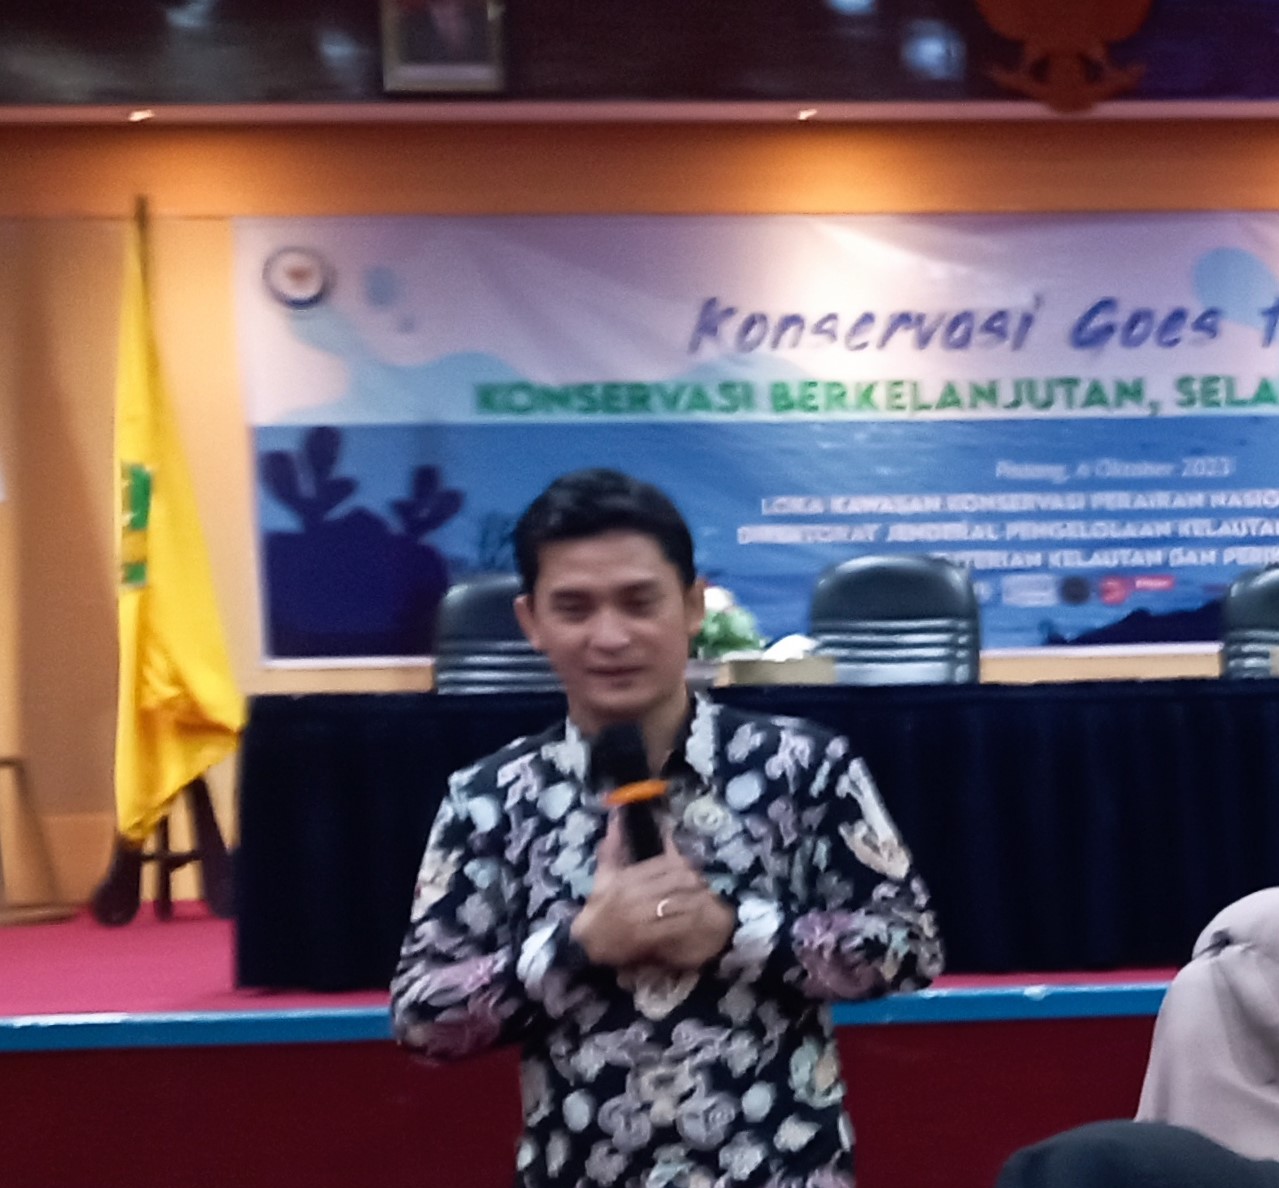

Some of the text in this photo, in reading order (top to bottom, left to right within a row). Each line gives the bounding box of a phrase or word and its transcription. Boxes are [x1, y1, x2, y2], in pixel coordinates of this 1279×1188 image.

[687, 296, 1043, 353] Konservasi
[1070, 296, 1222, 349] Goes
[476, 380, 754, 415] KONSERVASI
[771, 377, 1159, 416] BERKELANJUTAN,
[947, 492, 1086, 513] KONSERVASI
[1048, 548, 1163, 568] KELAUTAN
